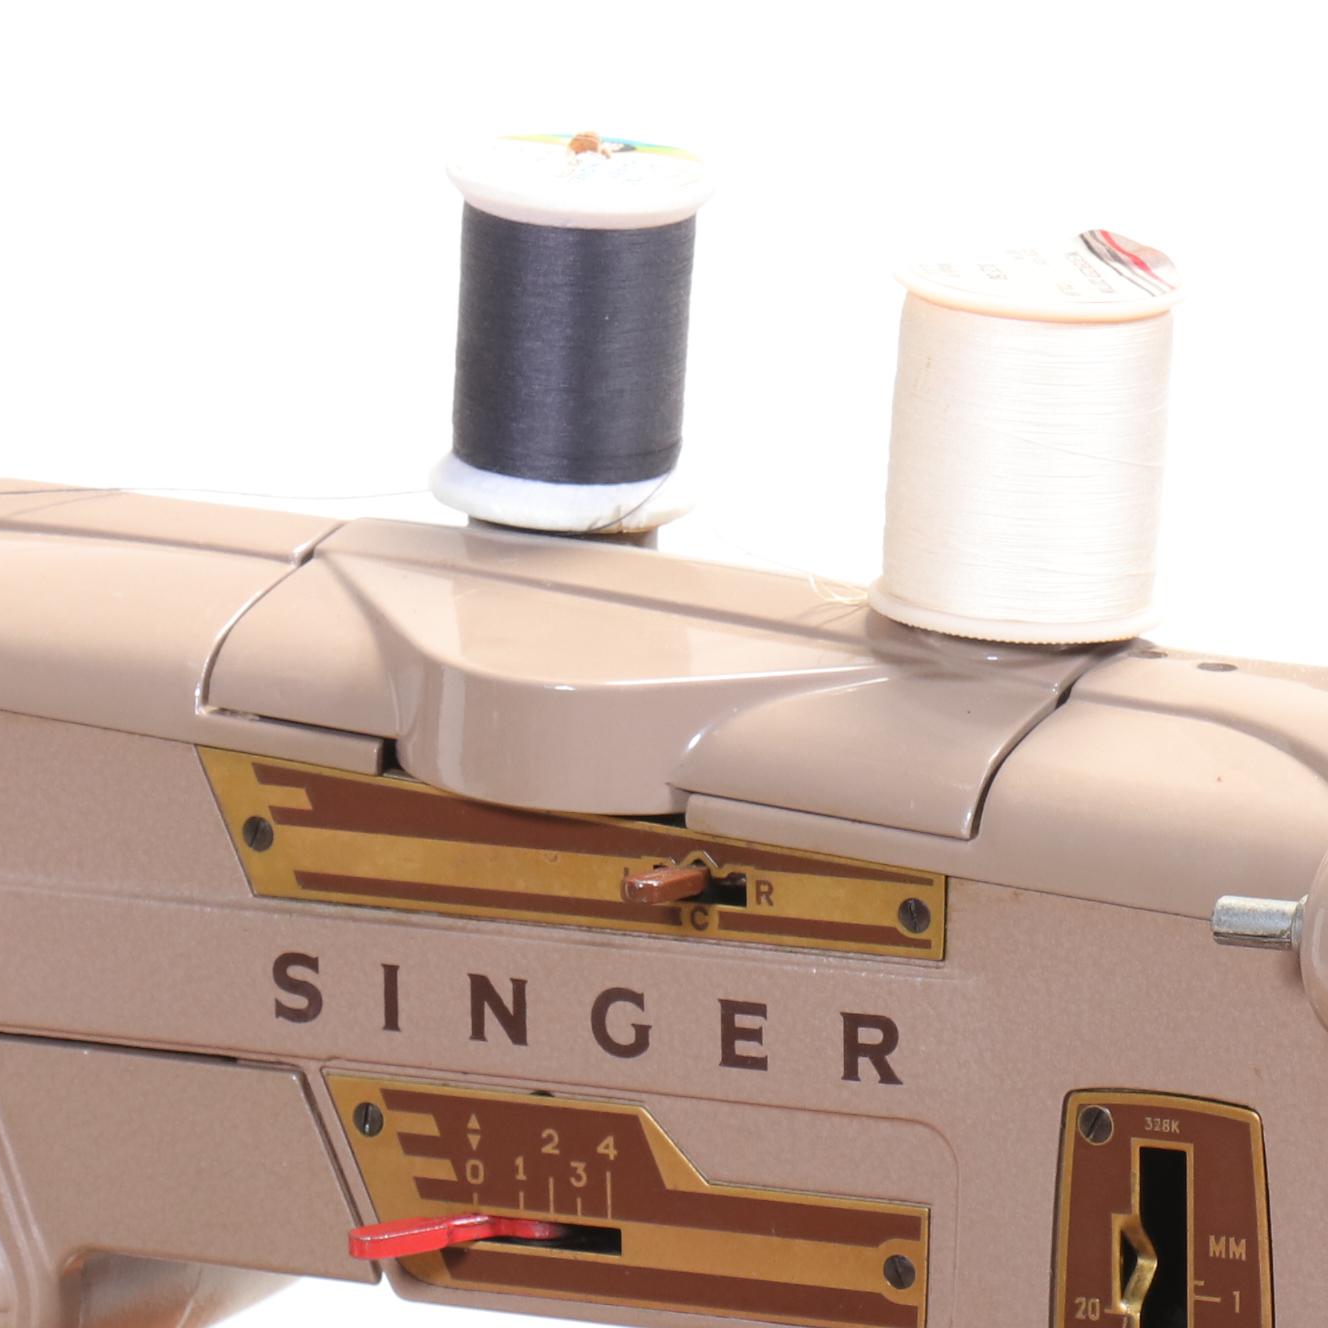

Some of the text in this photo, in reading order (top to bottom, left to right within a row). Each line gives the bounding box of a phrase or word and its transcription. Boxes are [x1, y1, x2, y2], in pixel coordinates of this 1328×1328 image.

[755, 880, 774, 906] R
[690, 908, 709, 931] C
[273, 952, 903, 1086] SINGER
[1144, 1116, 1180, 1134] 328K
[465, 1128, 618, 1188] 0 1 2 3 4
[1209, 1235, 1247, 1261] MM
[1075, 1298, 1100, 1321] 20
[1232, 1291, 1240, 1313] 1
